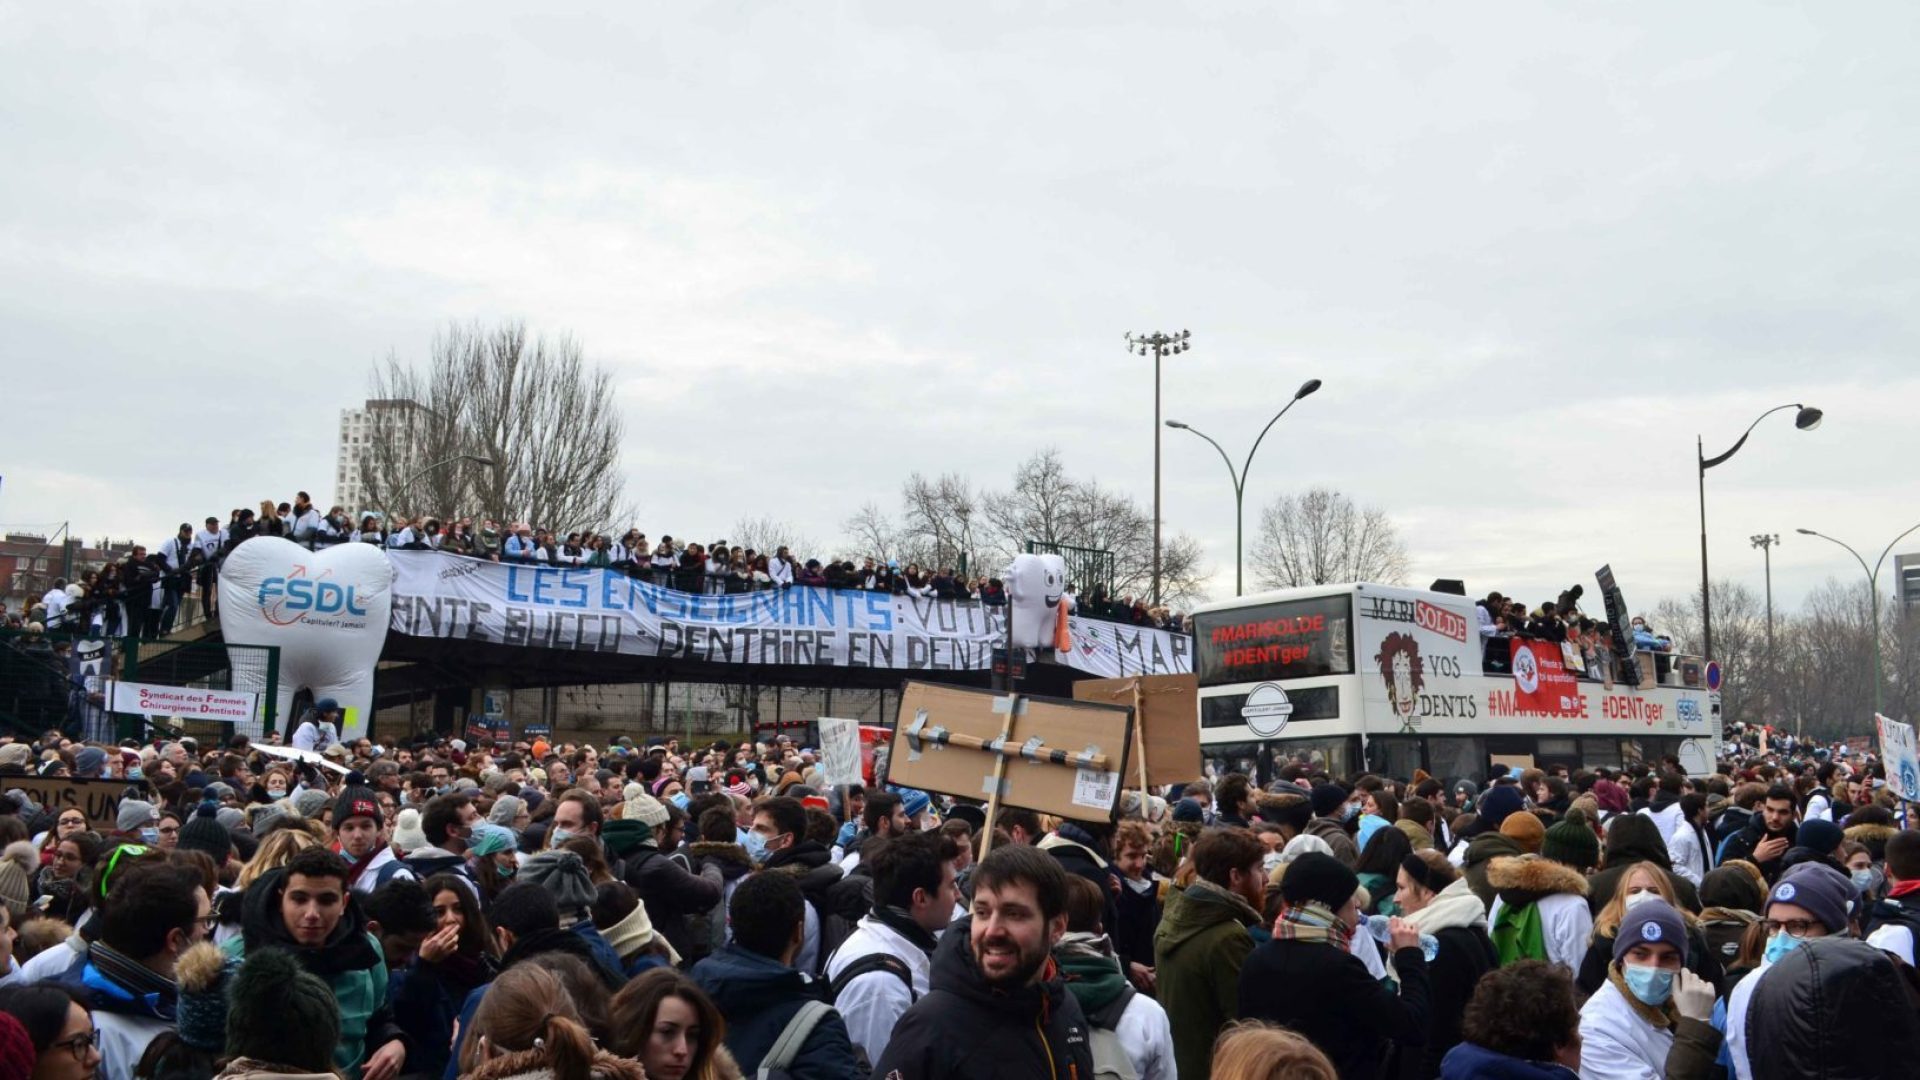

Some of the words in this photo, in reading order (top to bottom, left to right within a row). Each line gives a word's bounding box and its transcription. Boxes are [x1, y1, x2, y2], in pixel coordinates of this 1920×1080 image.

[258, 577, 366, 616] FSDL
[508, 566, 590, 608] LES
[504, 607, 622, 651] BUCCO
[848, 633, 893, 668] EN
[1211, 615, 1326, 645] #MARISOLDE
[1223, 645, 1311, 666] #DENTger
[1428, 655, 1461, 678] VOS
[140, 688, 184, 701] Syndicat
[186, 694, 204, 703] des
[207, 694, 247, 706] Femmes
[140, 700, 197, 713] Chirurgiens
[200, 704, 247, 716] Dentistes
[1419, 694, 1477, 719] DENTS
[1602, 695, 1663, 726] #DENTger
